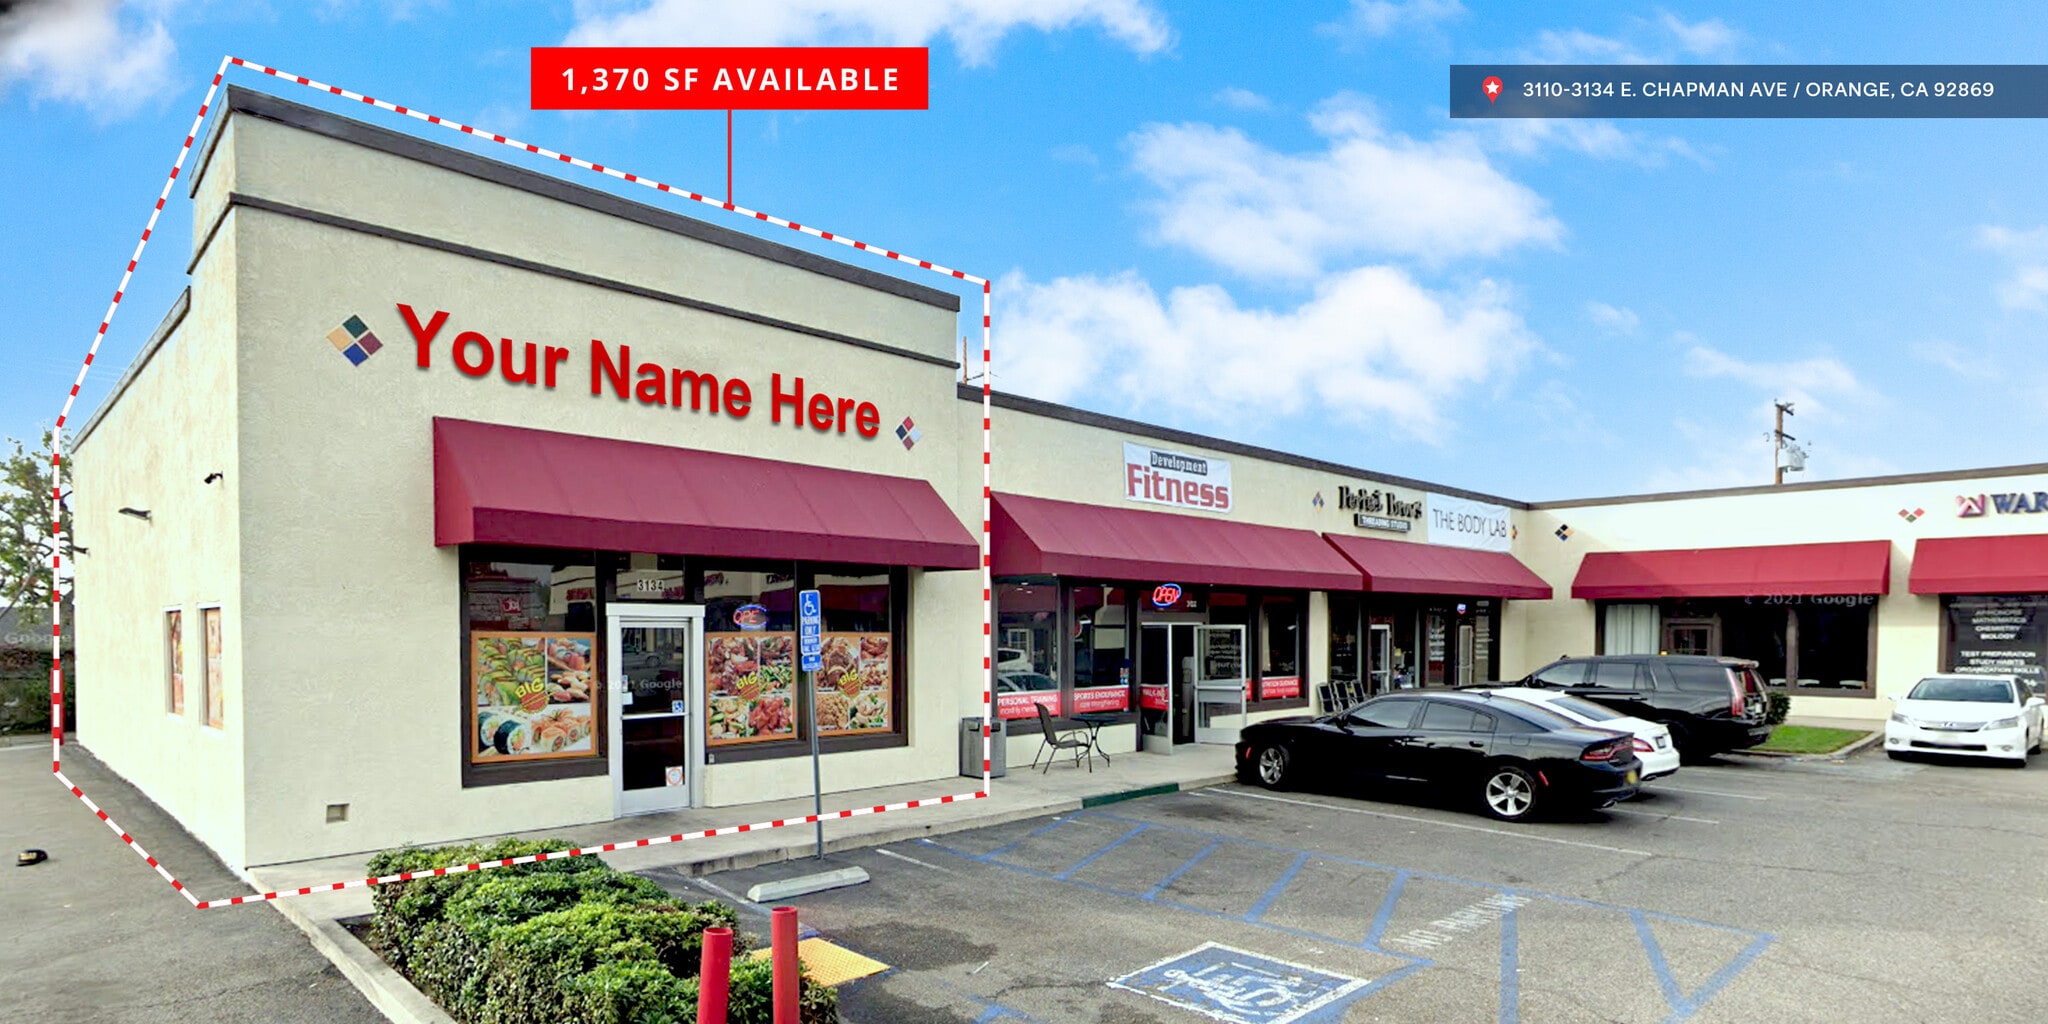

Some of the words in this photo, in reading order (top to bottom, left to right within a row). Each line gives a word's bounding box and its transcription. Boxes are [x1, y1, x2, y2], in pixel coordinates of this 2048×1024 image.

[1151, 451, 1208, 474] Development
[1126, 462, 1229, 509] Fitness
[1433, 508, 1455, 531] THE
[1457, 513, 1487, 535] BODY
[1489, 517, 1508, 539] LAB
[637, 579, 665, 592] 3134
[1153, 586, 1180, 604] OPEN
[733, 608, 762, 625] OPE
[1969, 658, 1995, 666] STUDY
[1980, 650, 2037, 658] PREPARATION
[839, 668, 859, 685] BIG
[1954, 666, 2012, 674] ORGANIZATION
[2013, 666, 2040, 674] SKILLS
[514, 677, 545, 698] BIG
[736, 671, 759, 690] BIG
[1073, 692, 1095, 701] SPORTS
